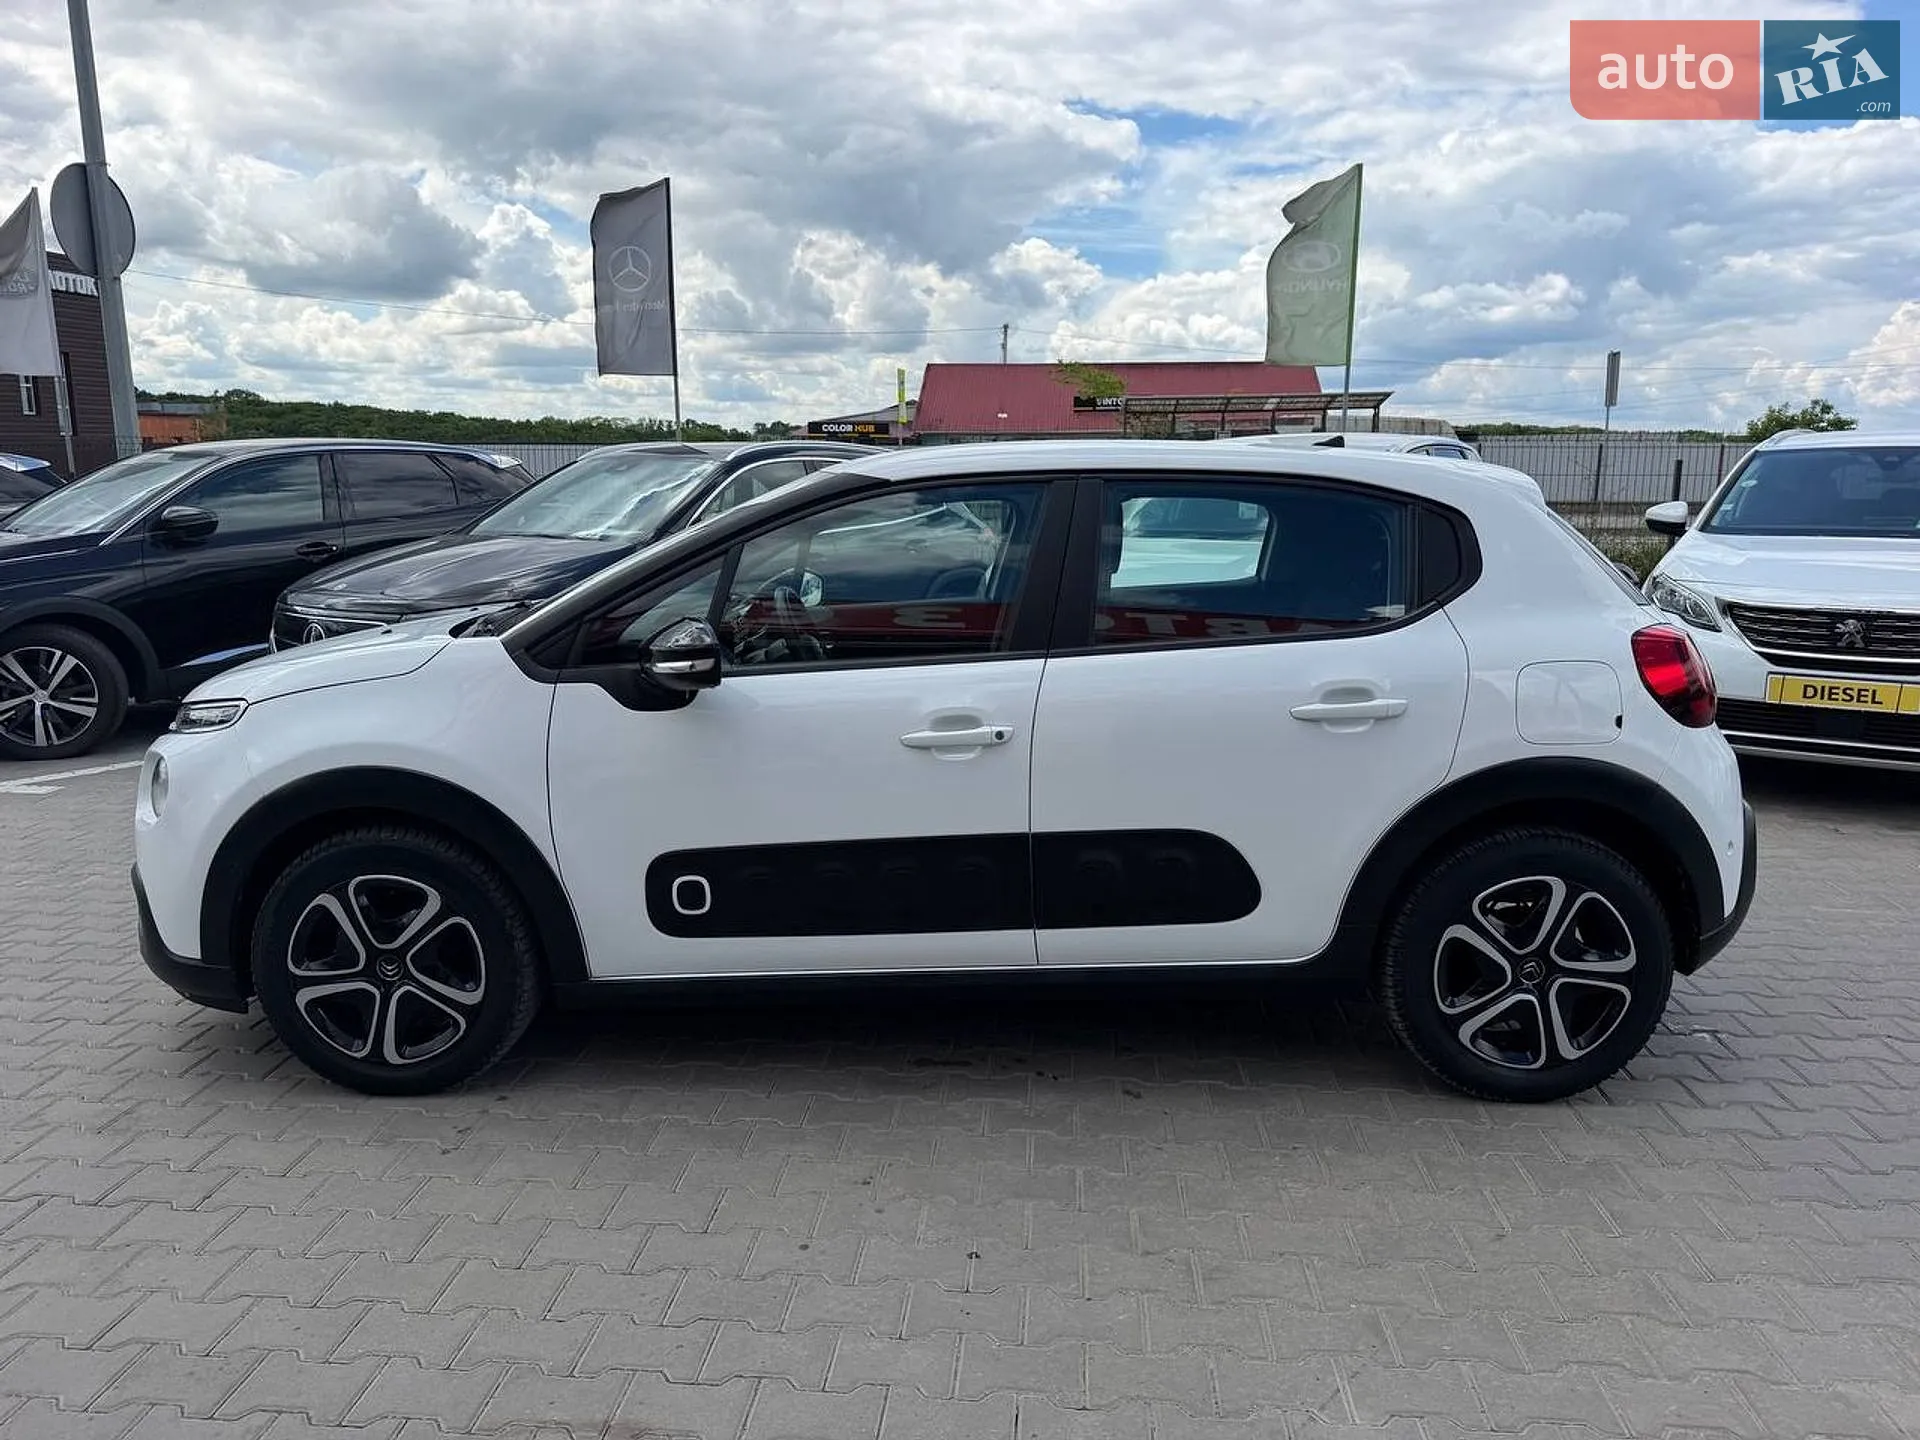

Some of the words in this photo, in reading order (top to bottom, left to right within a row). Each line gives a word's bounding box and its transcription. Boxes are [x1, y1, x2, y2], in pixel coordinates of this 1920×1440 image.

[822, 424, 853, 432] COLOR
[854, 424, 875, 432] HUB
[1802, 684, 1884, 705] DIESEL
